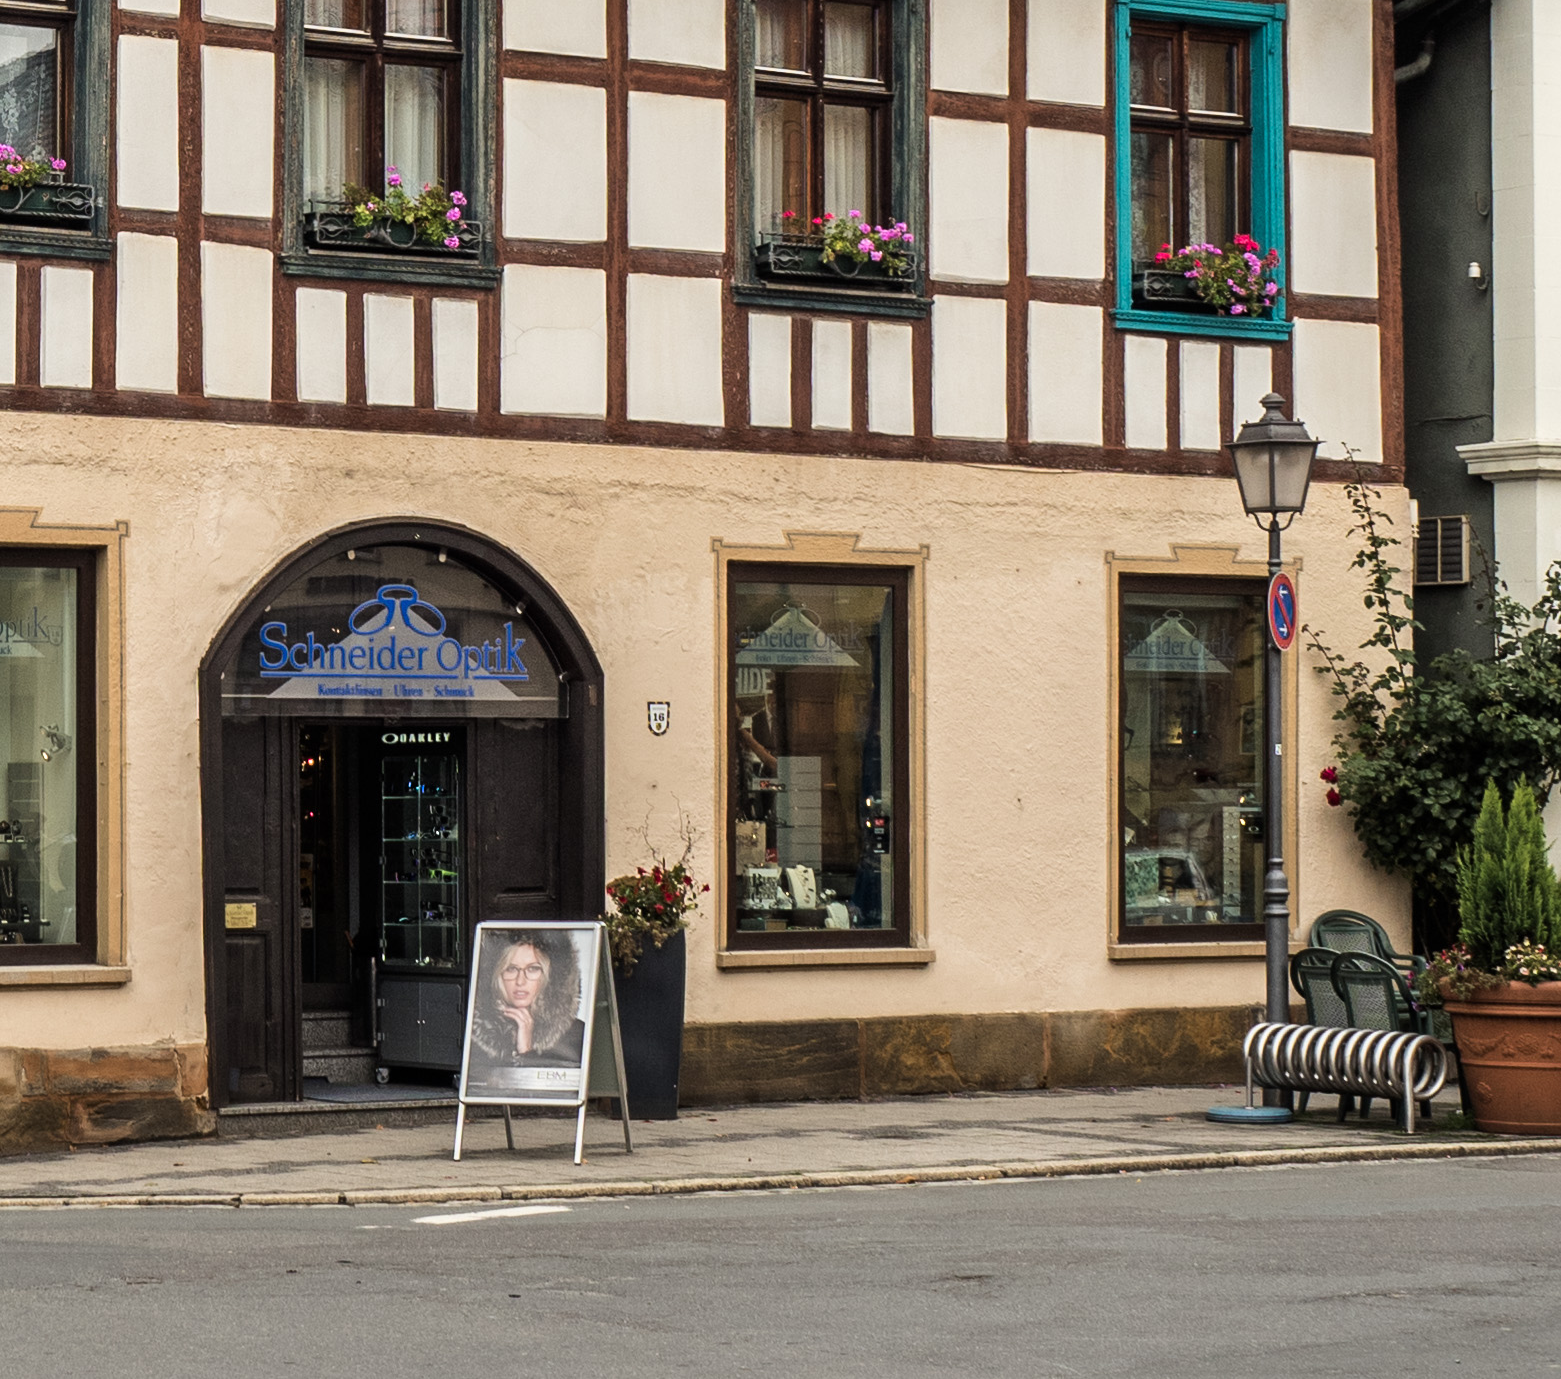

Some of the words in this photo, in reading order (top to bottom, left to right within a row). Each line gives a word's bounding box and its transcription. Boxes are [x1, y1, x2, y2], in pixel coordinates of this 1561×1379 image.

[736, 626, 810, 648] chneider
[259, 621, 427, 671] Schneider
[436, 622, 528, 679] Optik
[653, 712, 665, 722] 16
[399, 732, 451, 743] OAKLEY
